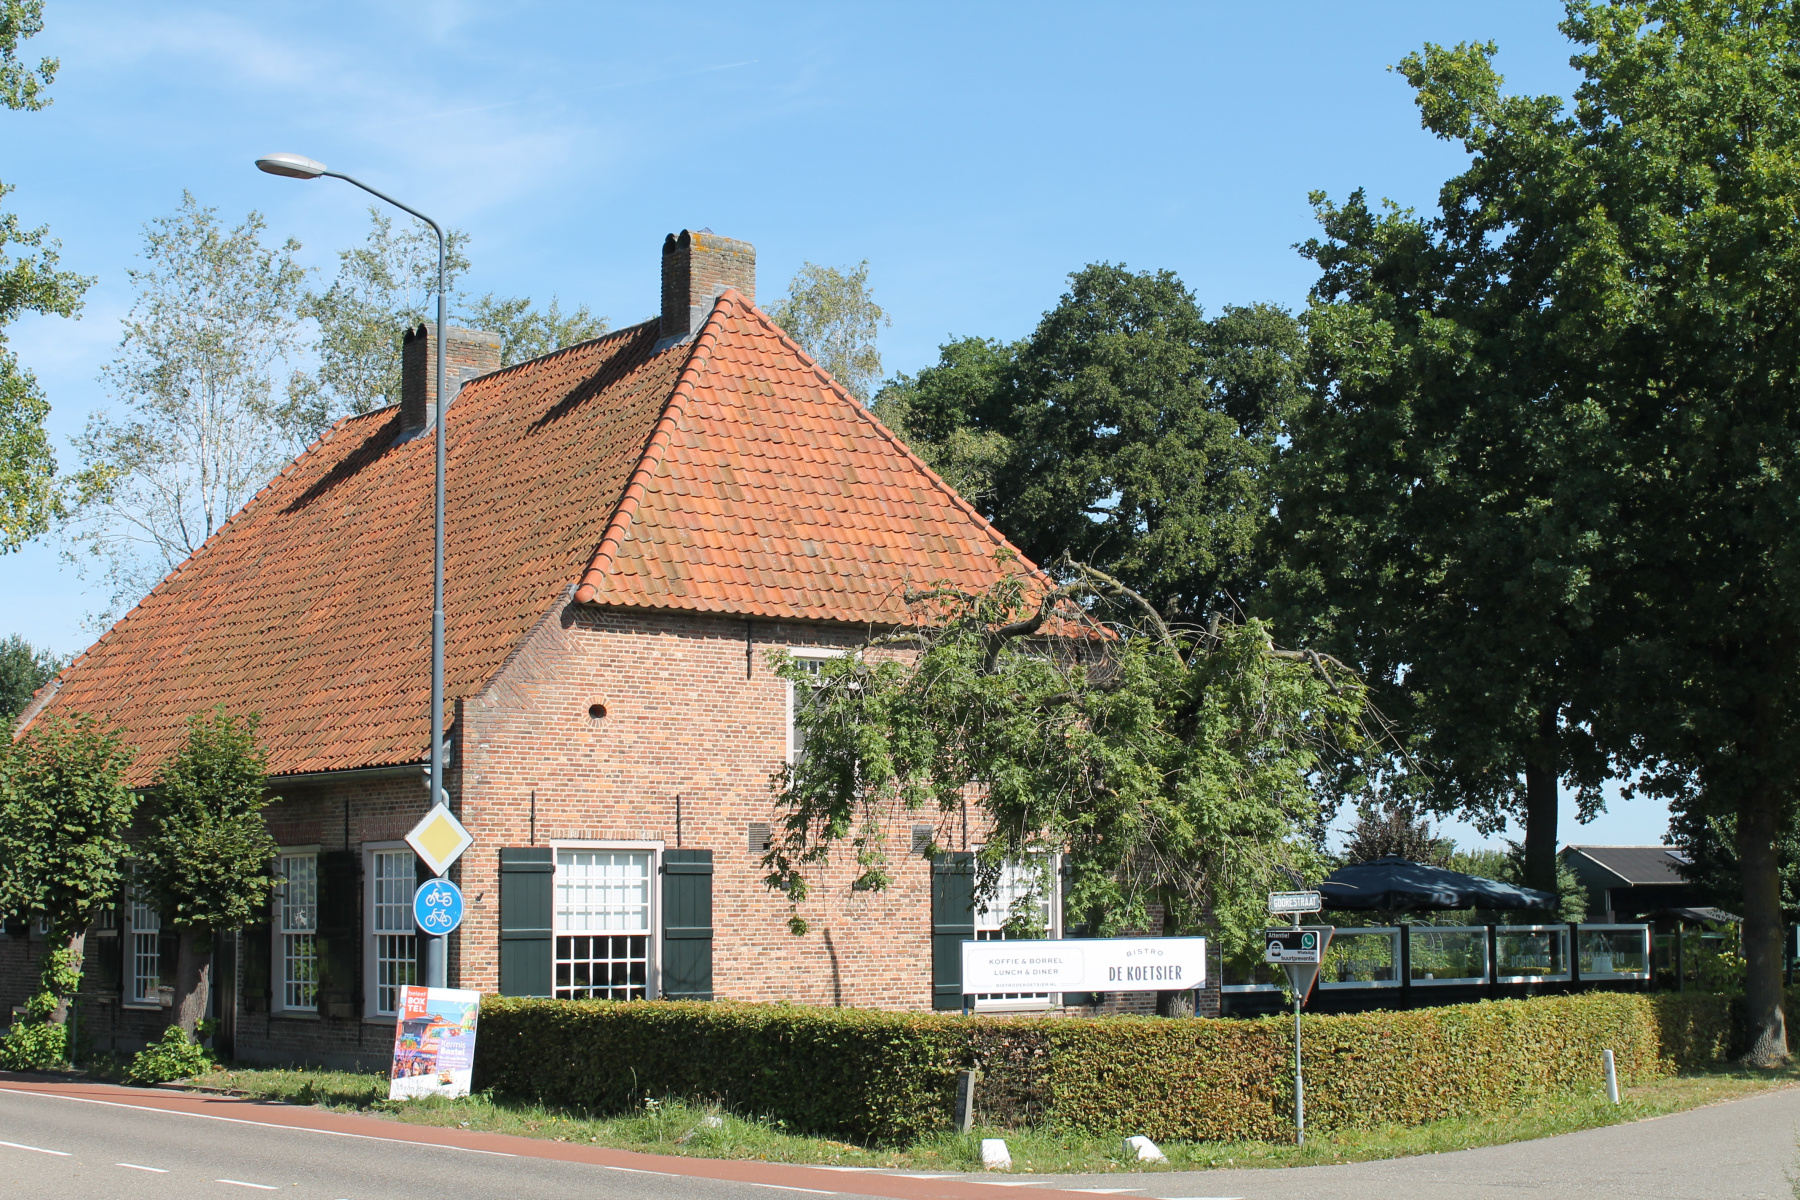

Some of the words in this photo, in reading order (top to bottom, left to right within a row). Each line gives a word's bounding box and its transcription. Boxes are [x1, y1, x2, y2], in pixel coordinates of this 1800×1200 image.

[1273, 896, 1317, 908] GOORESTRAAT
[1126, 948, 1164, 957] BISTRO
[1109, 966, 1123, 981] DE
[1127, 965, 1182, 981] KOETSIER
[408, 997, 425, 1005] BOX
[407, 1004, 425, 1013] TEL
[441, 1039, 466, 1049] Kermis
[440, 1047, 466, 1056] Boxtel
